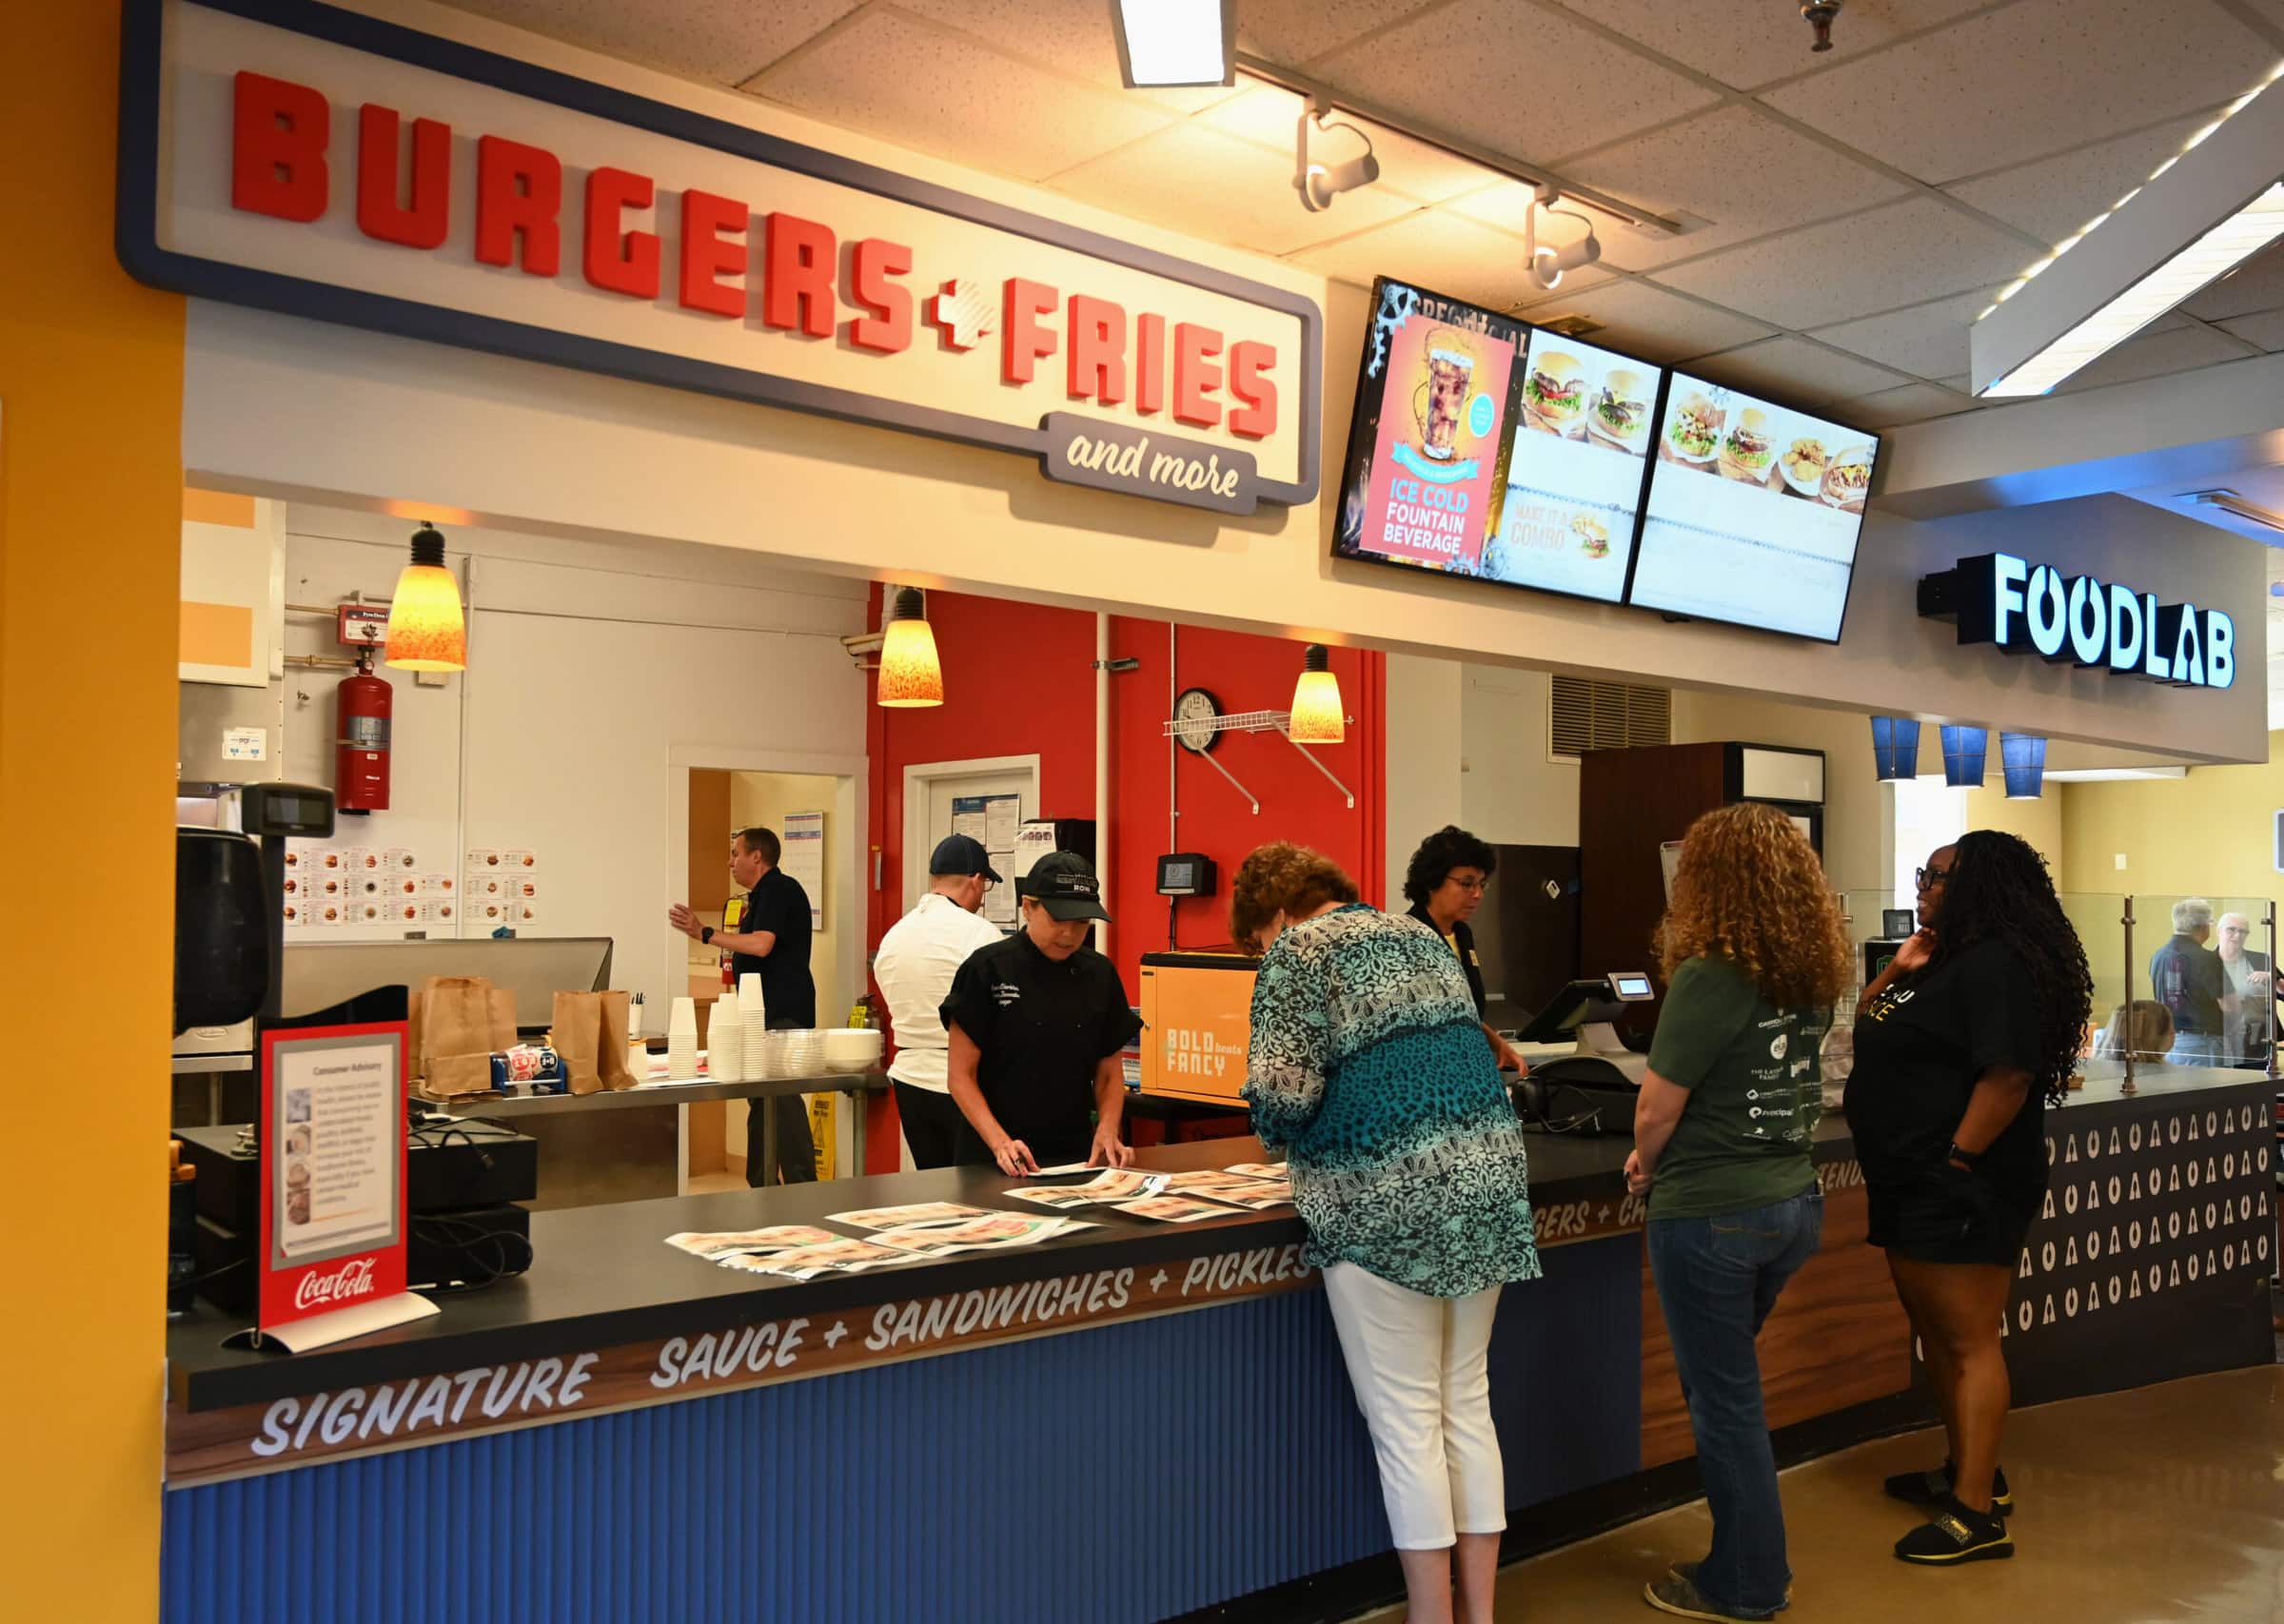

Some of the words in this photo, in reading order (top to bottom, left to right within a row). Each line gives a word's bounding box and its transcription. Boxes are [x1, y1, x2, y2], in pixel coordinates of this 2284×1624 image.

[231, 70, 913, 354] BURGERS
[1002, 276, 1277, 439] FRIES
[1067, 435, 1147, 478] and
[1150, 448, 1239, 498] more
[1389, 478, 1420, 503] ICE
[1423, 485, 1469, 513] COLD
[1387, 501, 1466, 535] FOUNTAIN
[1511, 521, 1565, 549] COMBO
[1383, 523, 1463, 555] BEVERAGE
[1994, 552, 2235, 689] FOODLAB
[1167, 1027, 1214, 1053] BOLD
[1167, 1051, 1226, 1077] FANCY
[1817, 1159, 1865, 1190] TEND
[249, 1353, 599, 1457] SIGNATURE
[650, 1318, 810, 1389] SAUCE
[823, 1321, 848, 1349] +
[864, 1266, 1134, 1351] SANDWICHES
[1149, 1269, 1169, 1294] +
[1181, 1242, 1310, 1297] PICKLES
